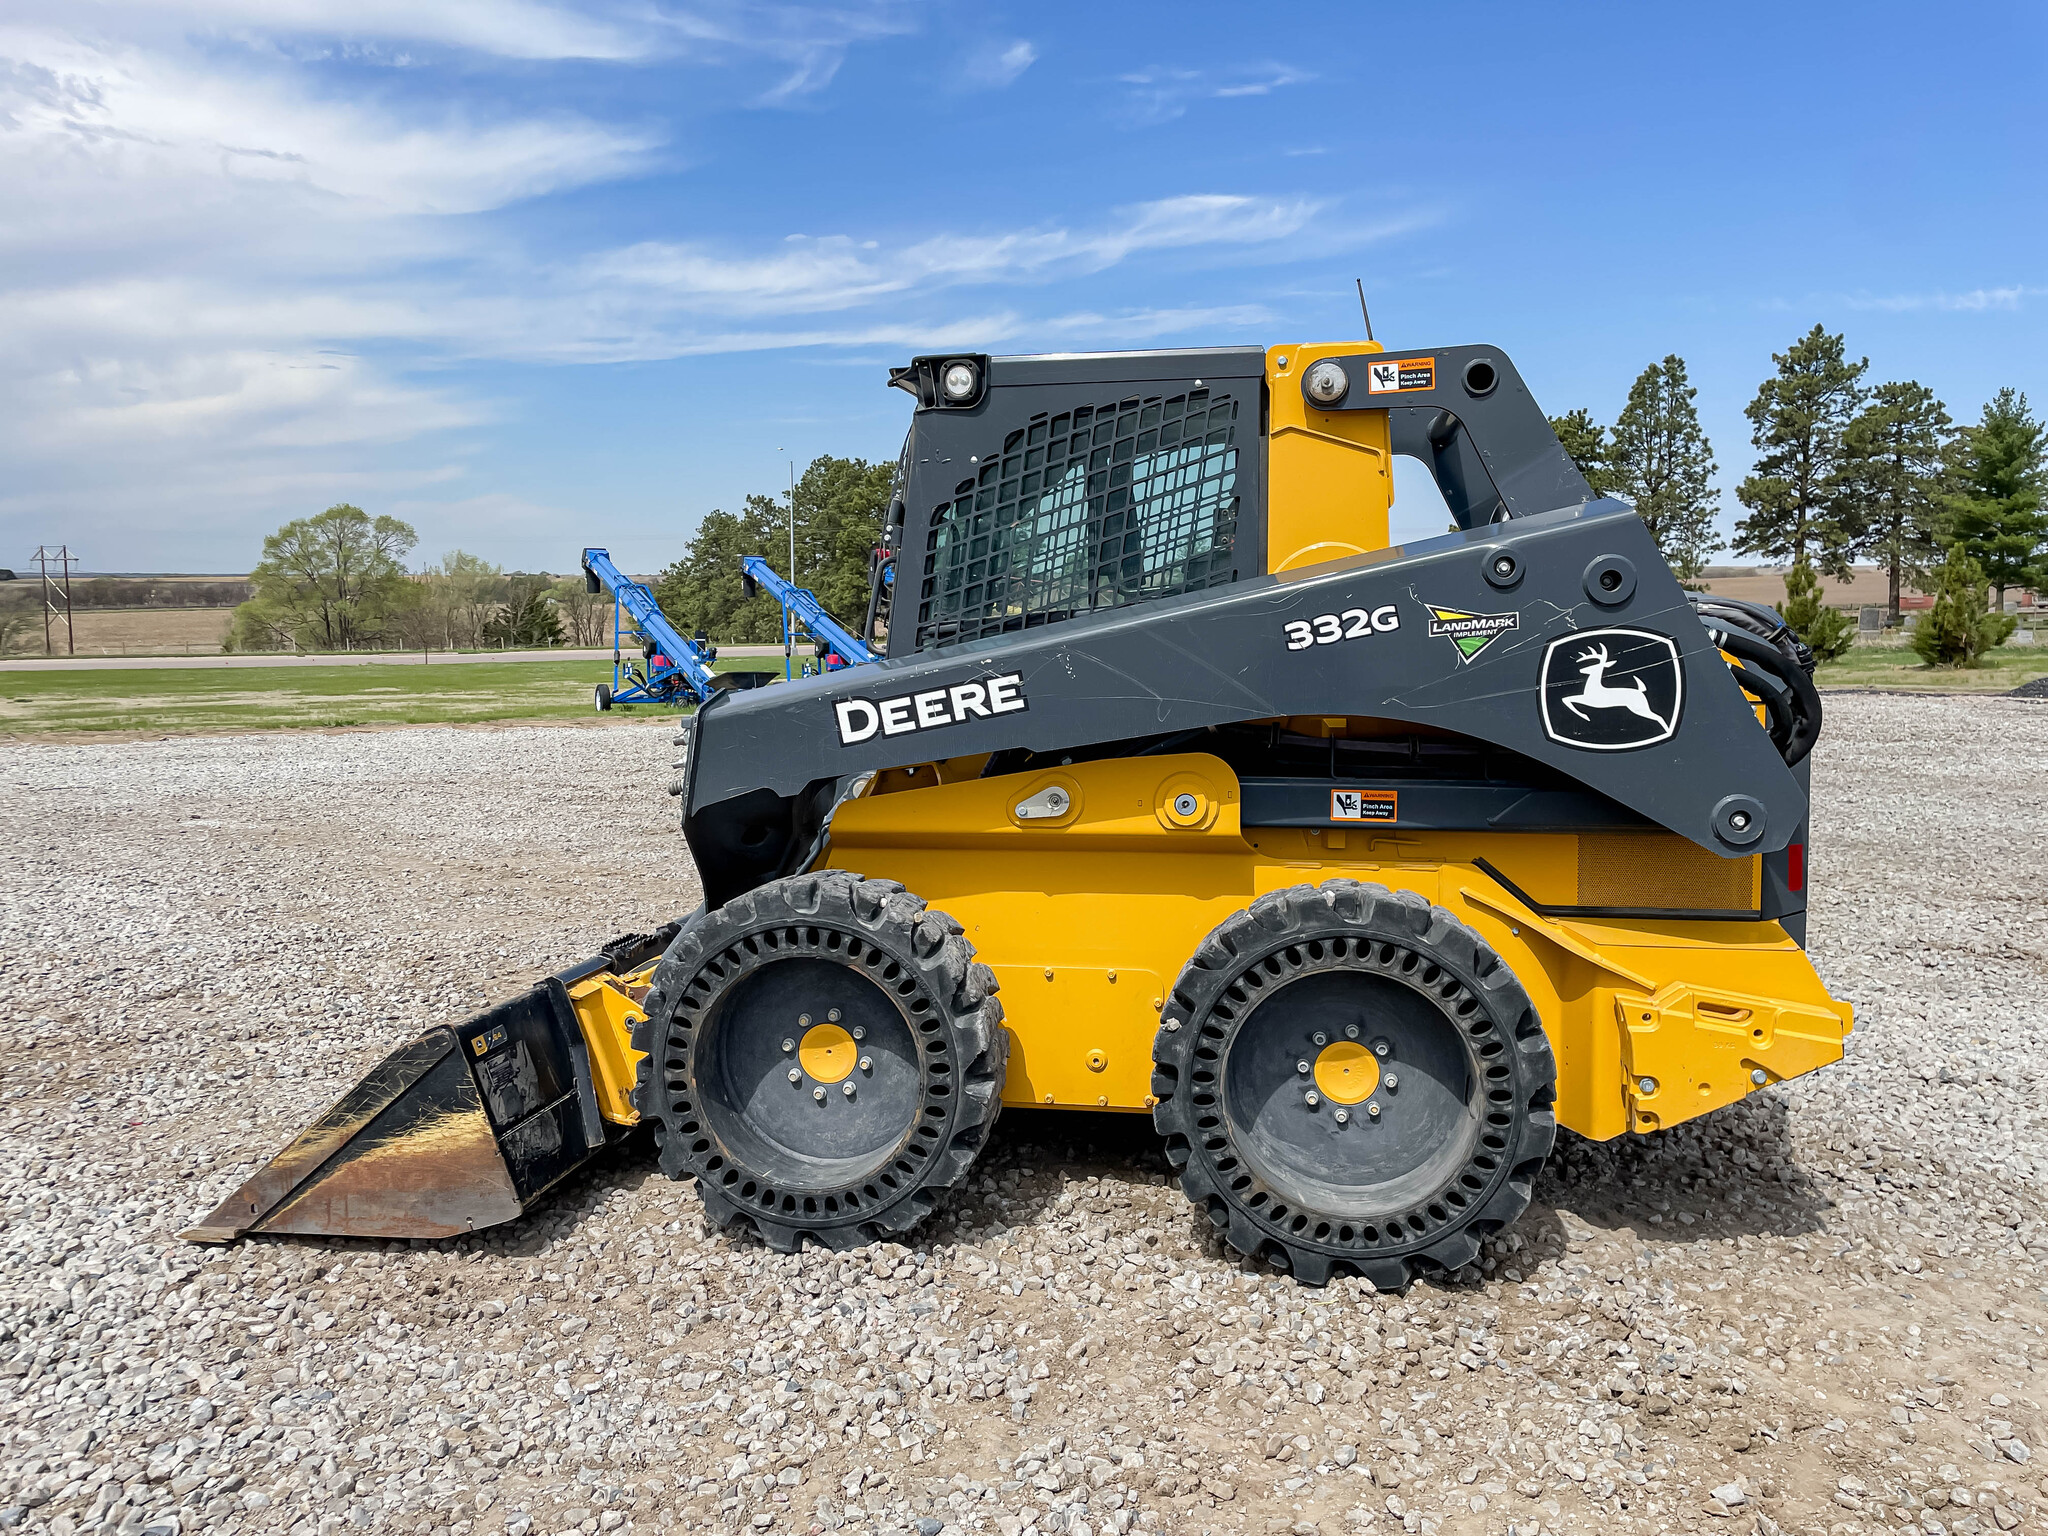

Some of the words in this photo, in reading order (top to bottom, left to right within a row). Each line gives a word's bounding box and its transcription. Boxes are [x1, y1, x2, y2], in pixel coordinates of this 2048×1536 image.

[1284, 605, 1399, 650] 332G
[1453, 629, 1498, 638] IMPLEMENT
[835, 674, 1025, 744] DEERE
